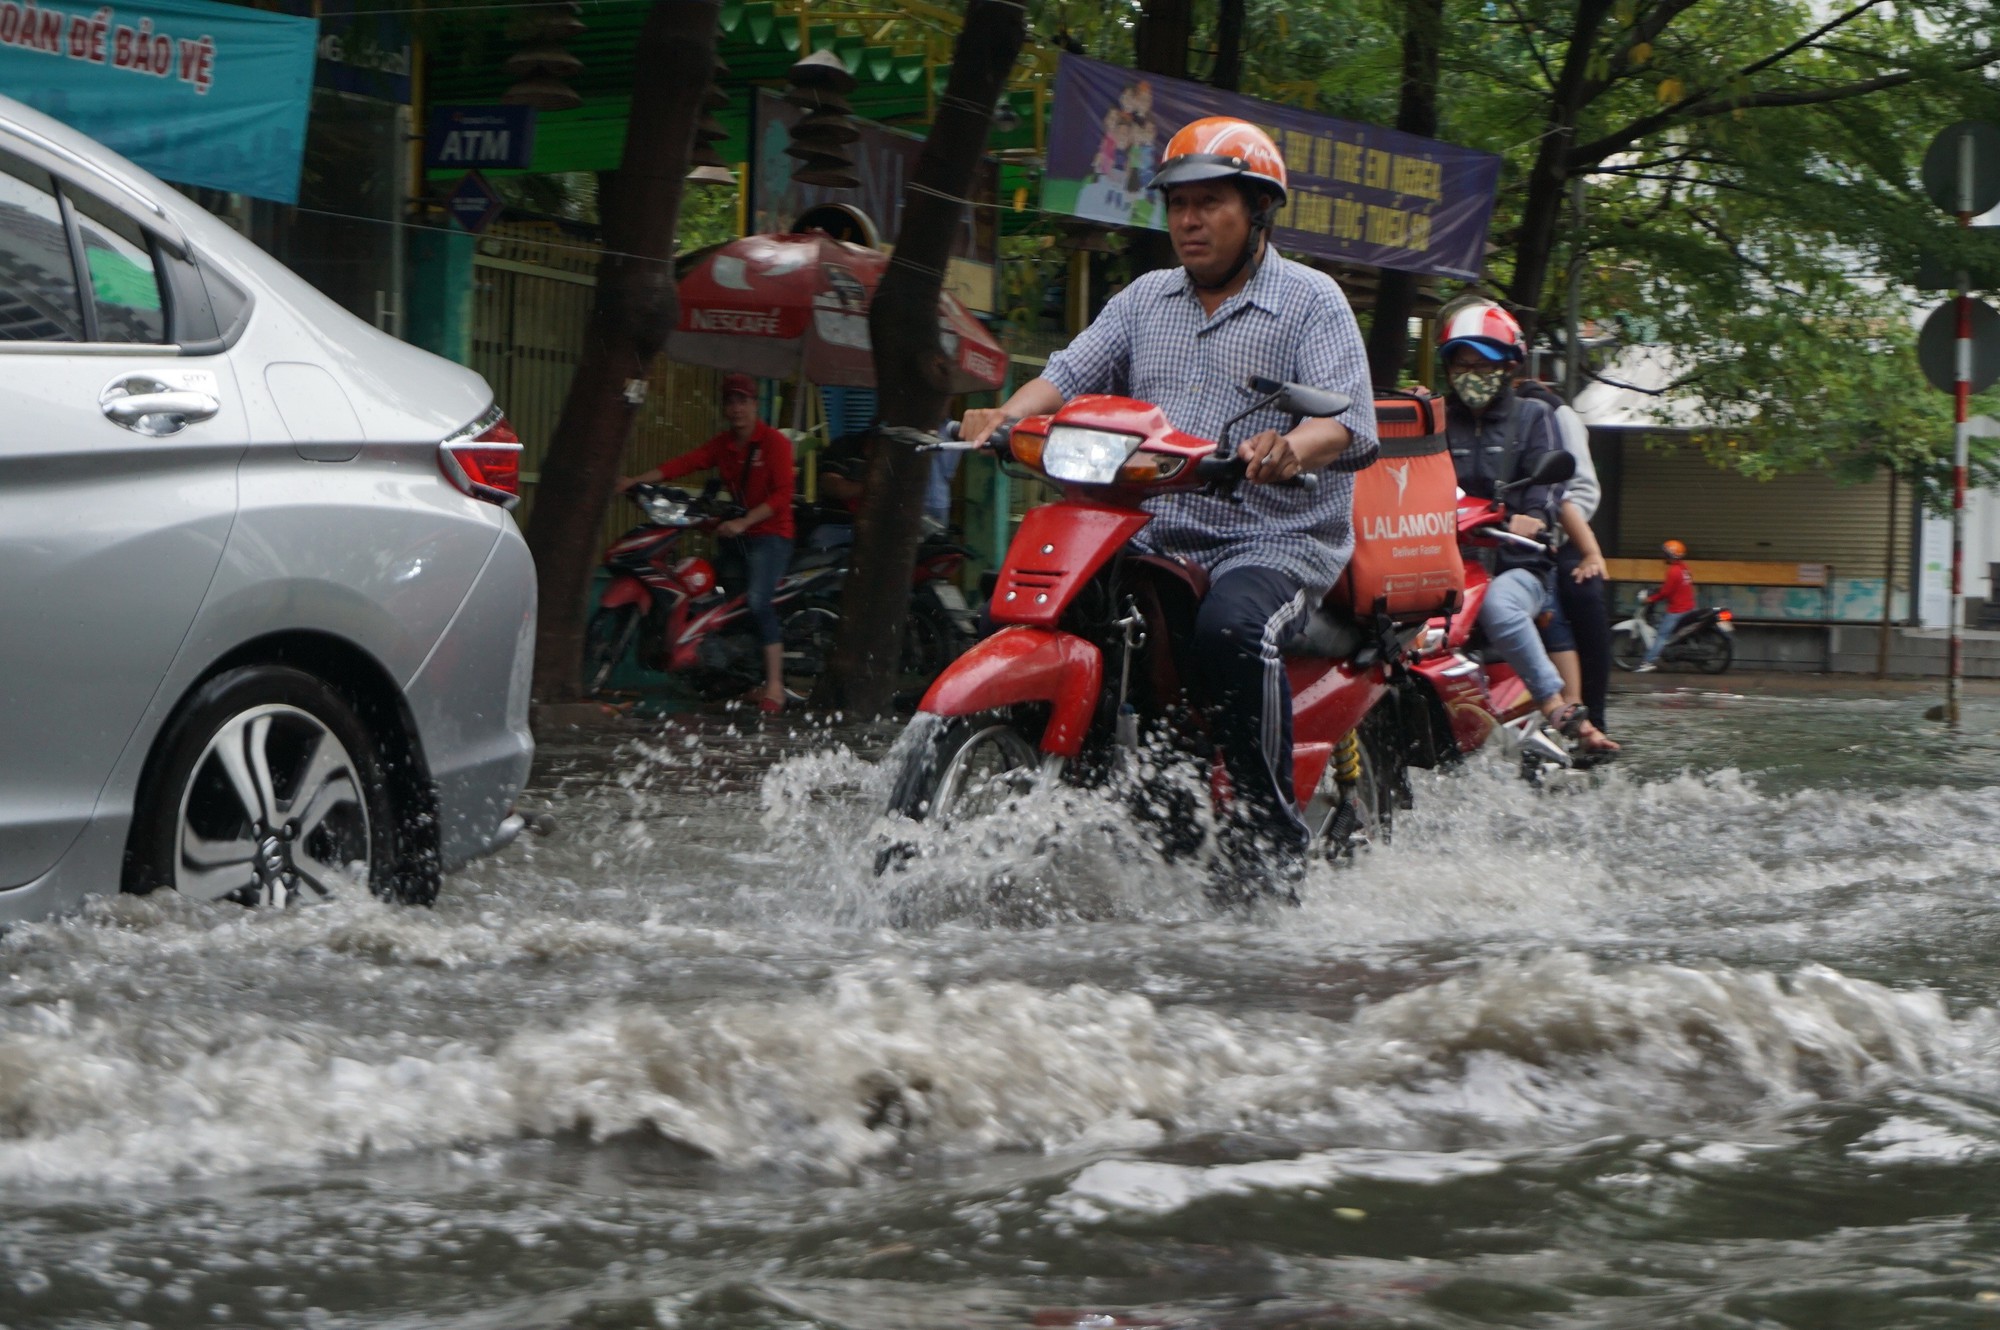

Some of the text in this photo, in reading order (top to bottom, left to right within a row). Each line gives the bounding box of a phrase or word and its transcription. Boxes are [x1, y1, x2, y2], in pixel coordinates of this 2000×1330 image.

[112, 16, 171, 77] BẢO
[177, 35, 217, 95] VỆ
[439, 130, 511, 161] ATM
[1363, 147, 1391, 190] EM
[690, 308, 781, 334] NESCAFÉ
[1362, 511, 1455, 540] LALAMOVE
[1392, 544, 1442, 558] Deliver Faster
